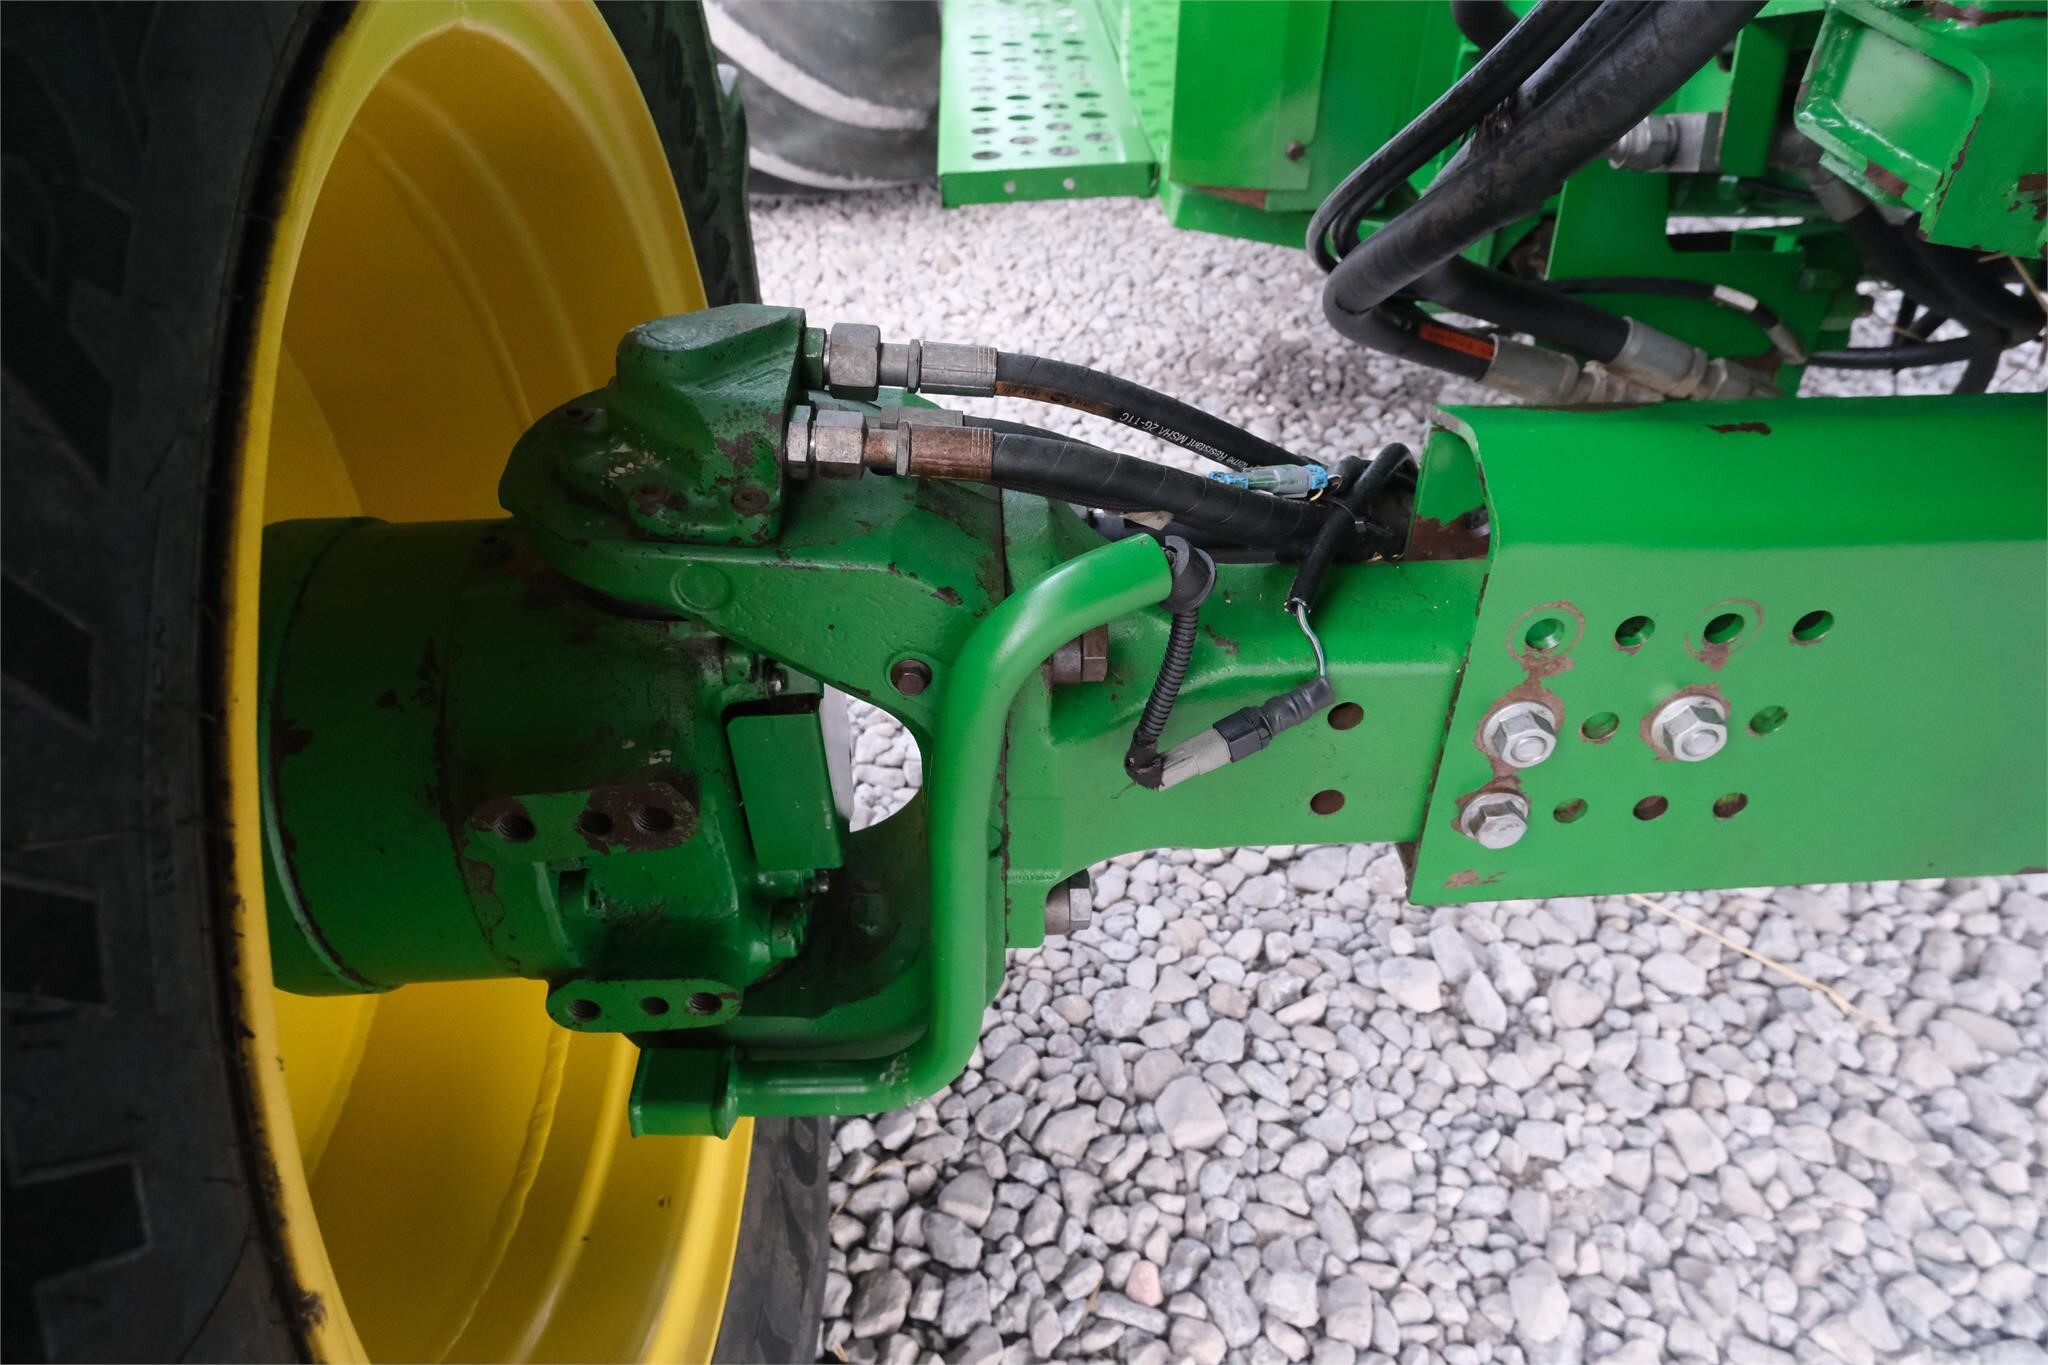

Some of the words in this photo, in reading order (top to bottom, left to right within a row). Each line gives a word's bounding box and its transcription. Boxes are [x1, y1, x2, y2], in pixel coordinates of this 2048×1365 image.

[1119, 412, 1159, 431] 2G-11C
[1160, 426, 1187, 444] MSHA
[1187, 438, 1228, 461] Resistant
